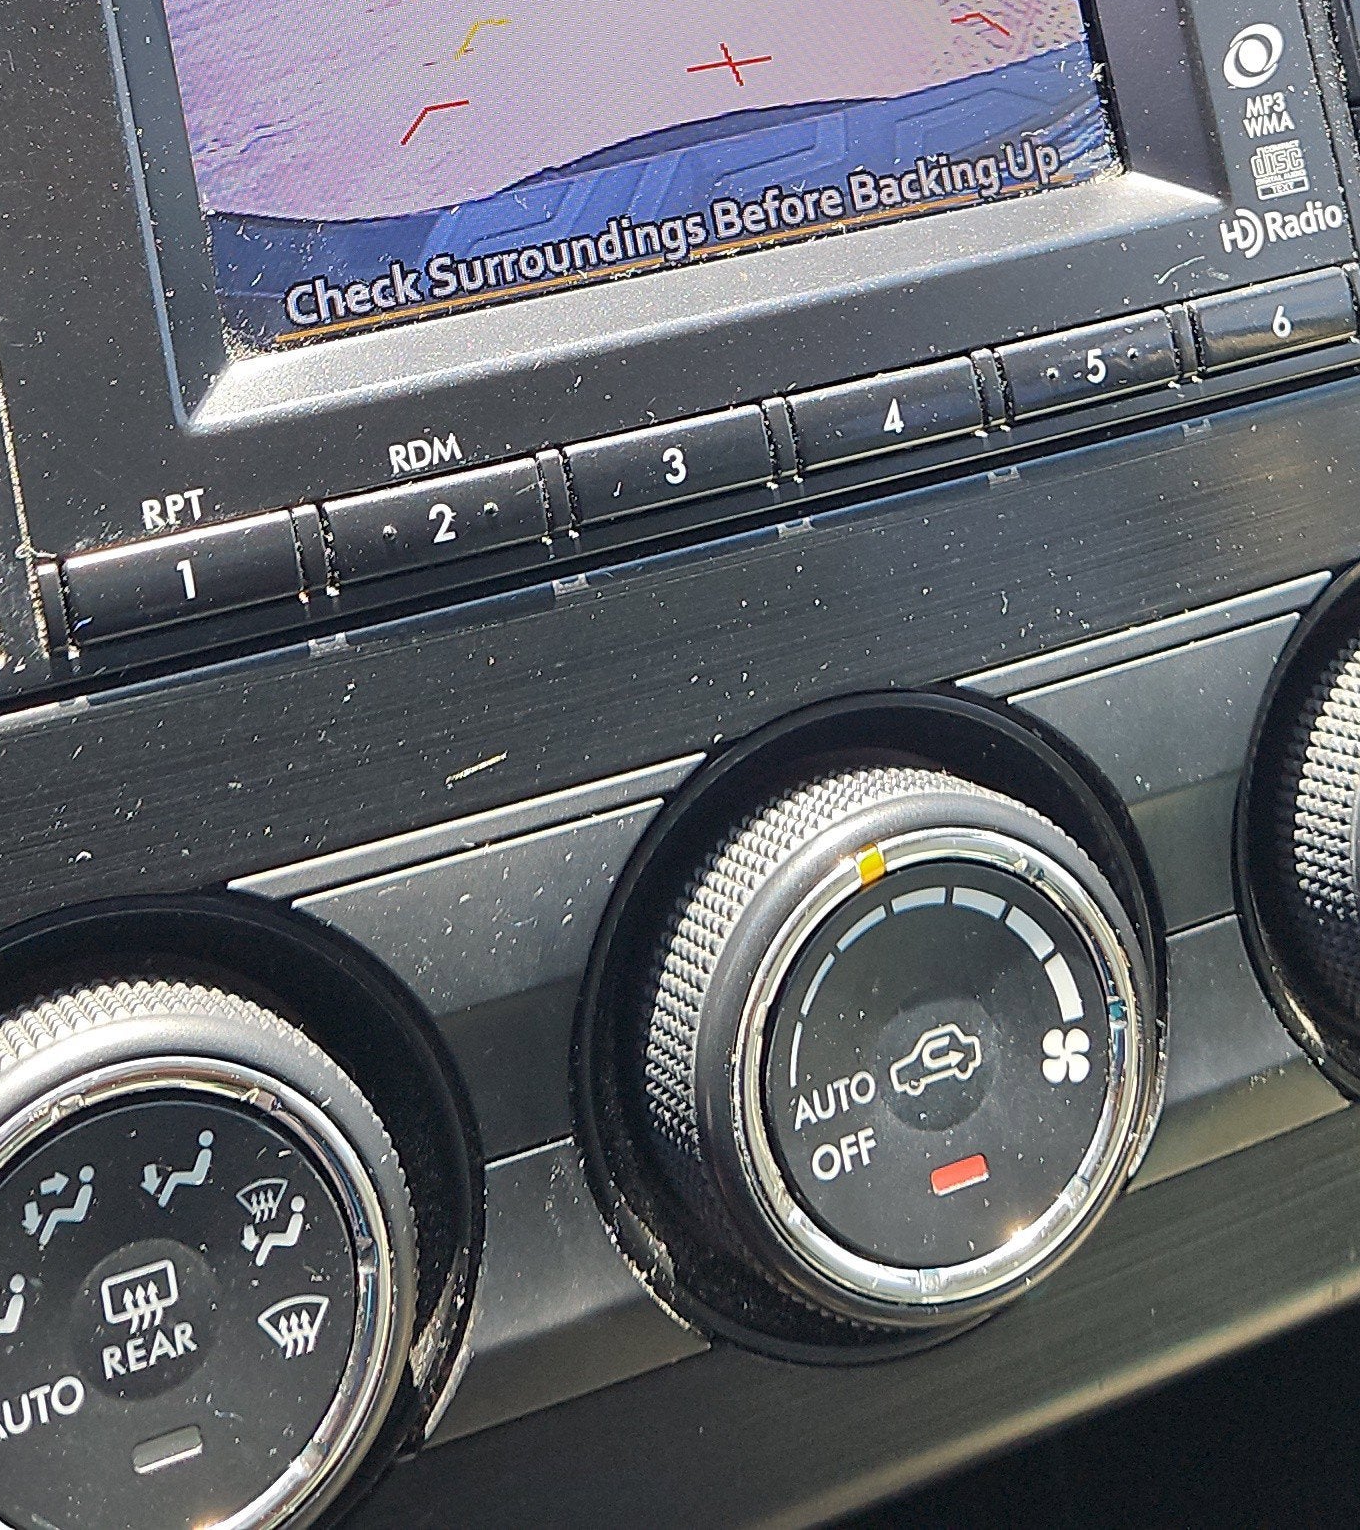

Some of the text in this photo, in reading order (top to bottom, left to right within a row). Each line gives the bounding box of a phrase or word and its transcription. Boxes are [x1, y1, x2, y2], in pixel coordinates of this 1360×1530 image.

[1243, 110, 1295, 139] WMA
[1246, 92, 1286, 118] MP3
[285, 139, 1061, 326] Check Surroundings Before Backing Up
[1264, 201, 1343, 243] Radio
[1272, 306, 1294, 339] 6
[1086, 349, 1108, 384] 5
[883, 398, 906, 435] 4
[388, 432, 464, 475] RDM
[662, 446, 689, 486] 3
[140, 488, 205, 531] RPT
[427, 503, 457, 545] 2
[176, 558, 198, 600] 1
[791, 1071, 876, 1131] AUTO
[811, 1126, 879, 1181] OFF
[101, 1322, 198, 1381] REAR
